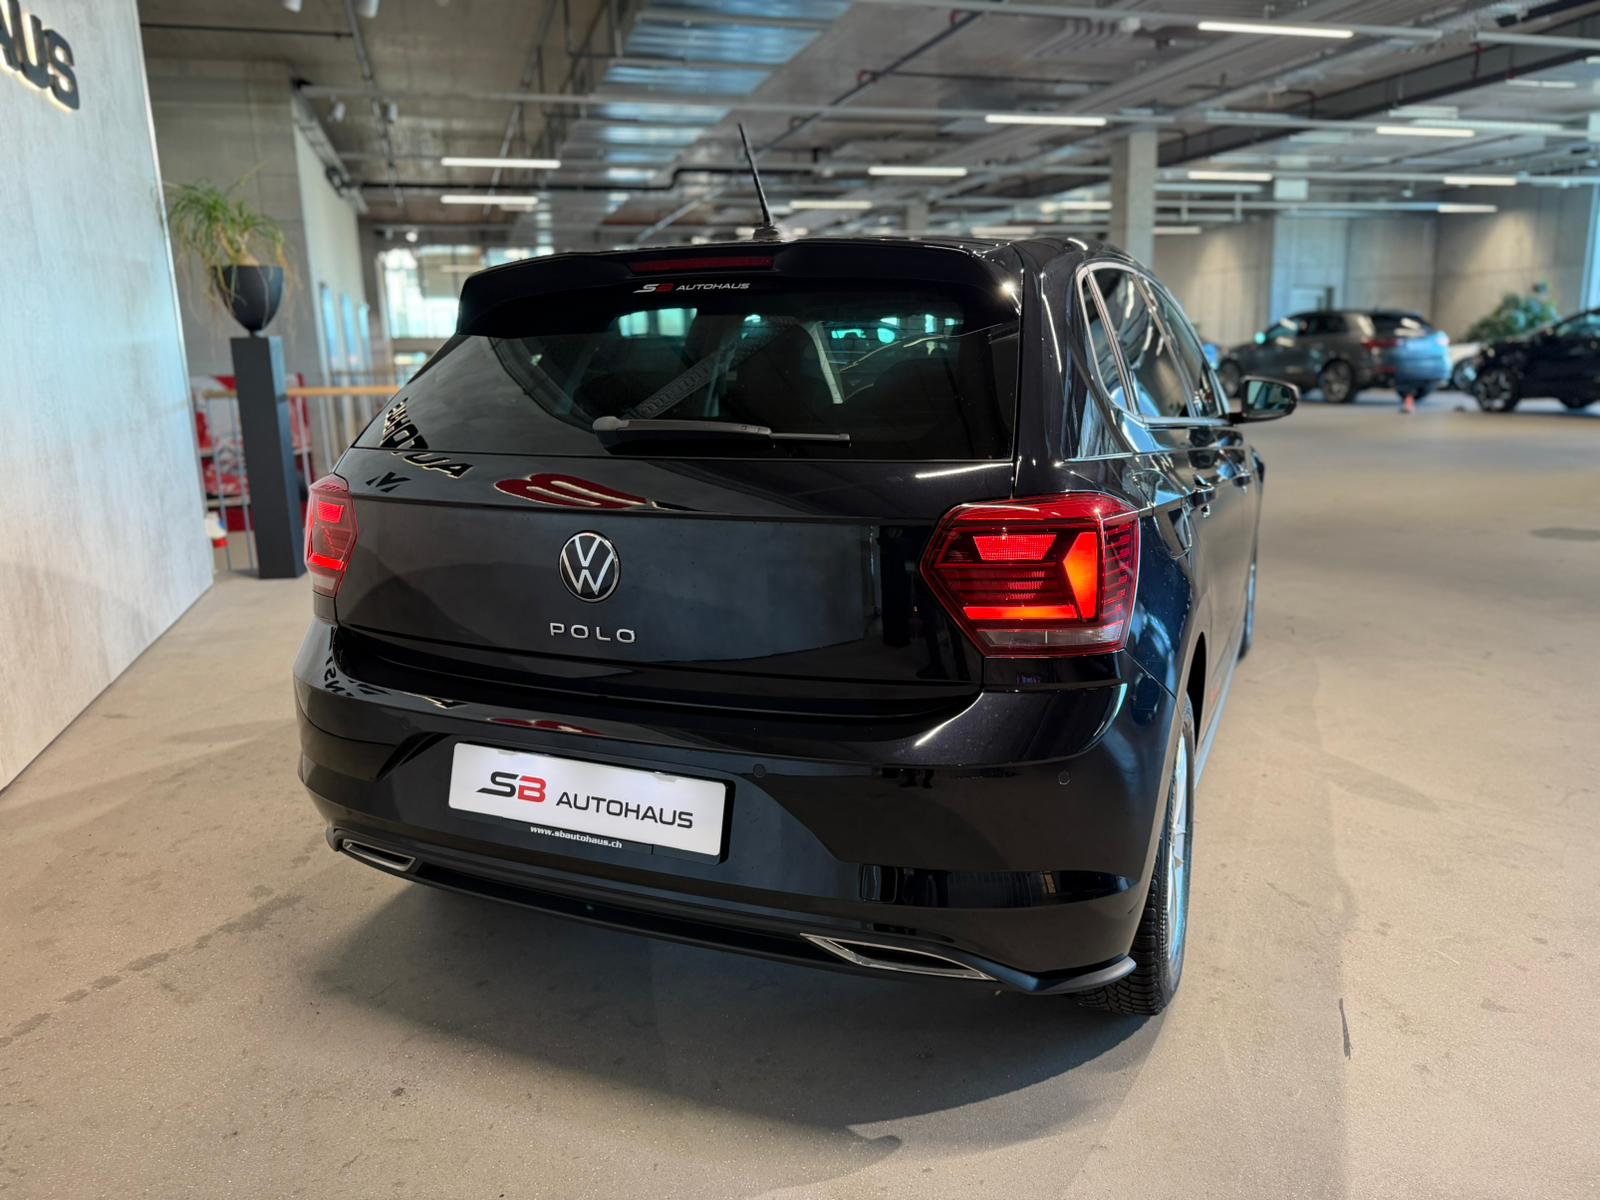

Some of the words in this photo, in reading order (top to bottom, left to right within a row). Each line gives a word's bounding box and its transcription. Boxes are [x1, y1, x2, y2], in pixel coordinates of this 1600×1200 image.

[675, 282, 751, 291] AUTOHAUS
[550, 622, 636, 643] POLO
[475, 771, 546, 803] SB
[556, 791, 694, 829] AUTOHAUS
[530, 825, 623, 849] www.sbautohaus.ch
